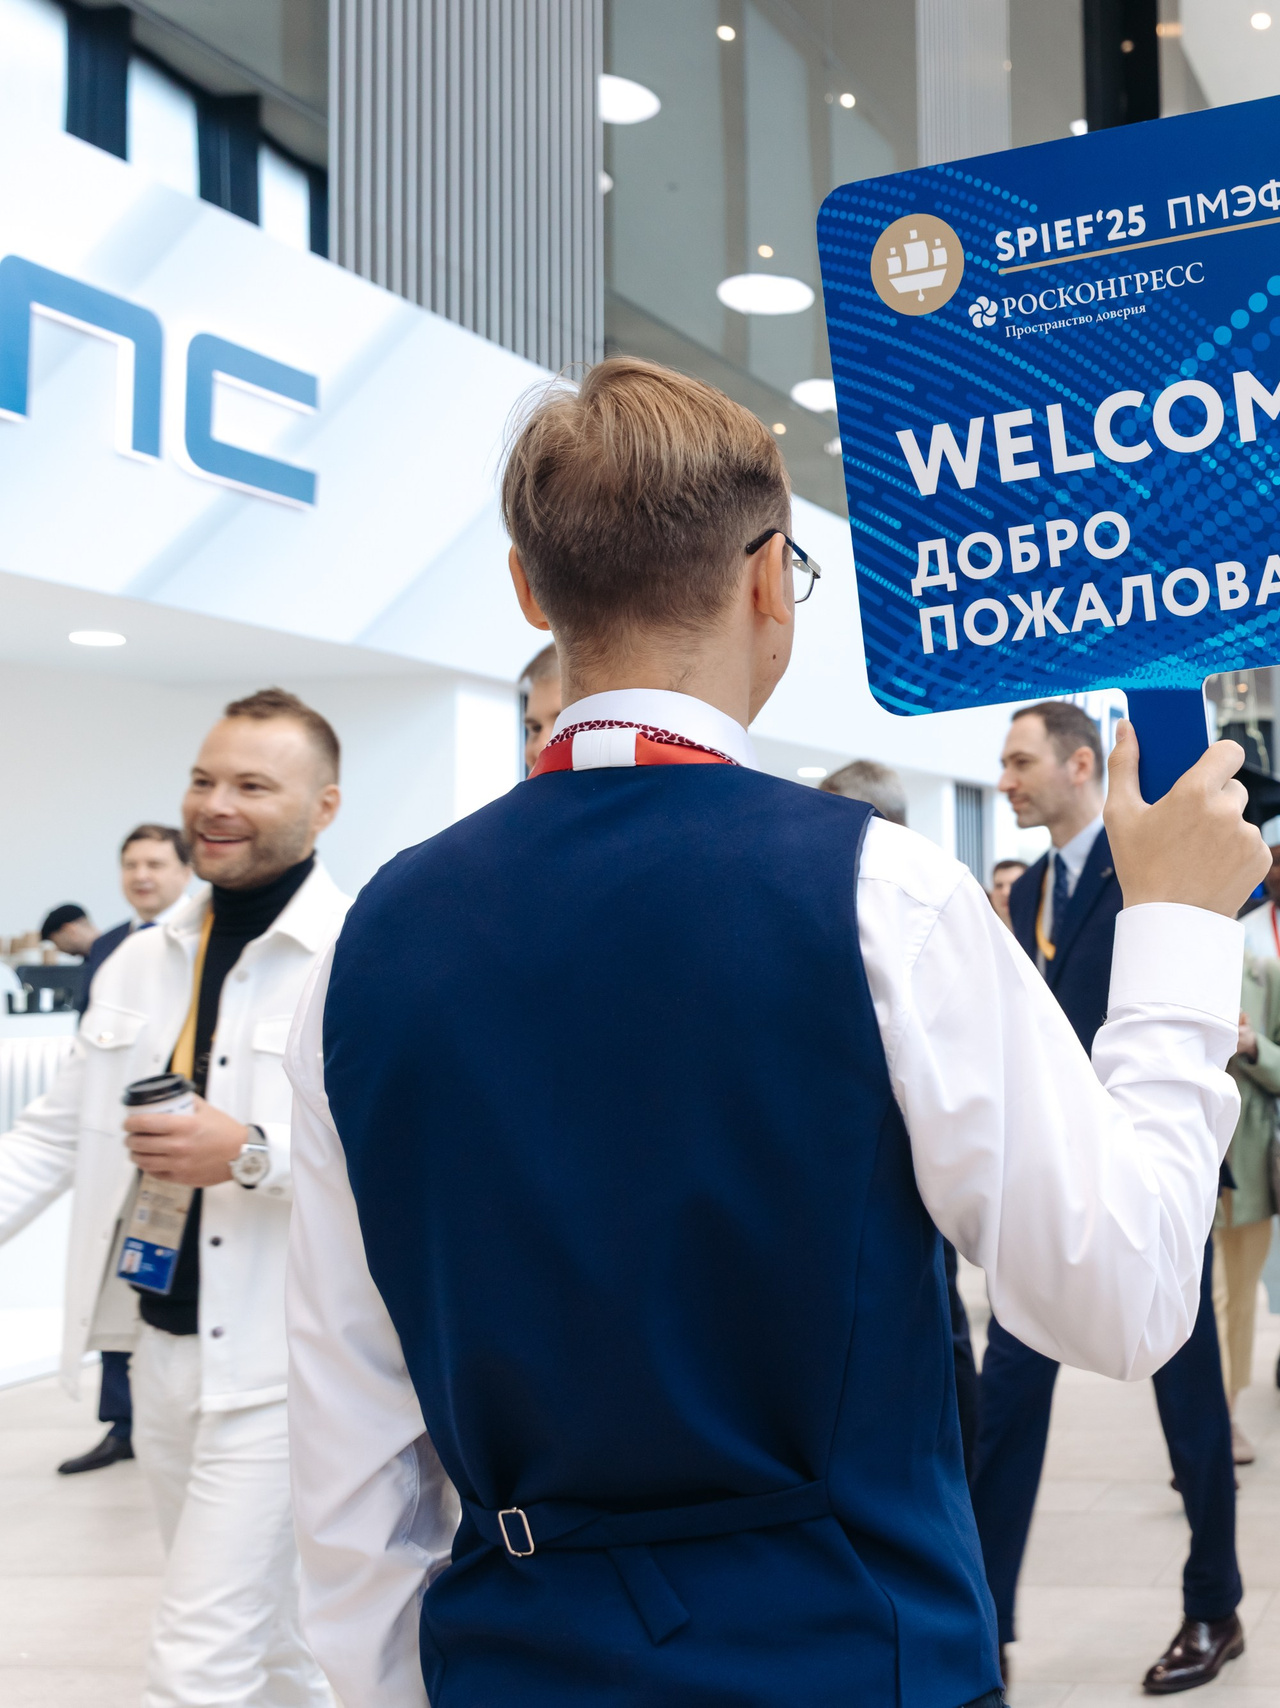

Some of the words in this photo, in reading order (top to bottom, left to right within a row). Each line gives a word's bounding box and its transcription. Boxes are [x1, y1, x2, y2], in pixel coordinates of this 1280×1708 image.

[995, 204, 1147, 262] SPIEF‘25
[1001, 261, 1205, 318] РОСКОНГРЕСС
[1005, 314, 1093, 340] Пространство
[1095, 304, 1147, 324] доверия
[910, 510, 1131, 597] ДОБРО
